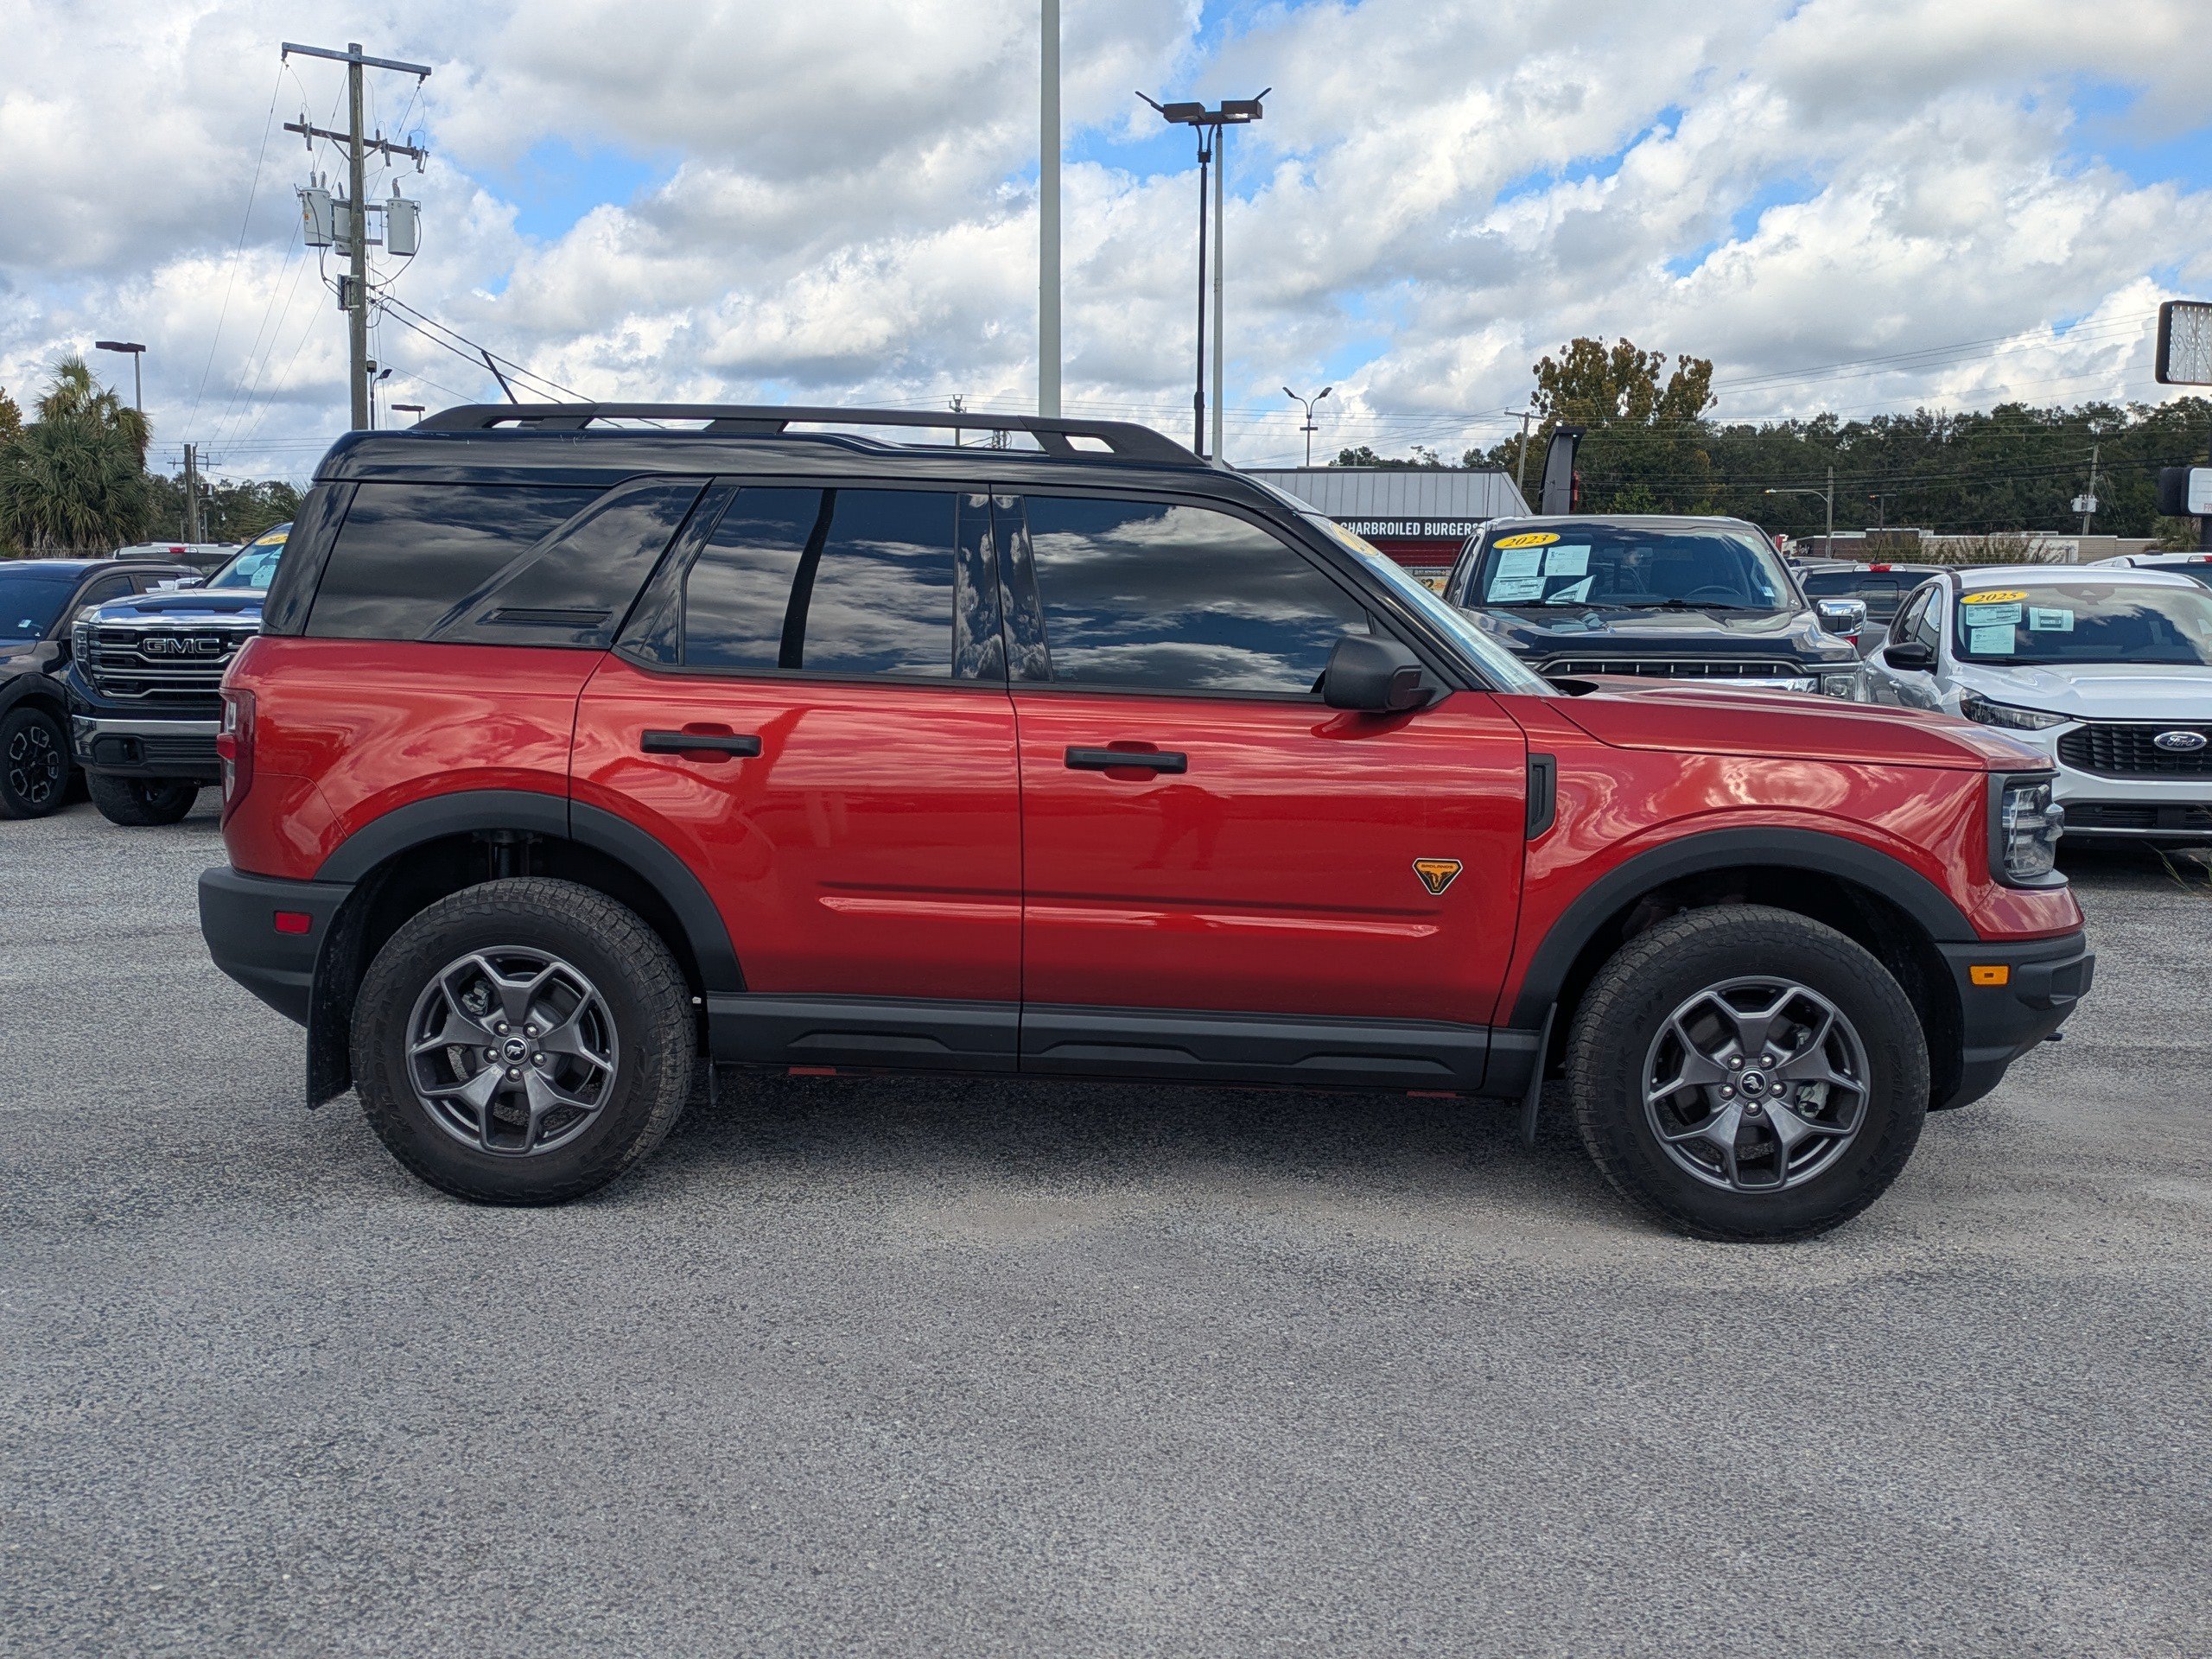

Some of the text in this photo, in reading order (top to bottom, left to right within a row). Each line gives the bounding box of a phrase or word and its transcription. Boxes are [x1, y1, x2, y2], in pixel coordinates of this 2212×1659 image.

[1504, 534, 1549, 547] 2023
[1974, 592, 2018, 603] 2025
[143, 638, 220, 654] GMC
[2166, 734, 2196, 747] Ford
